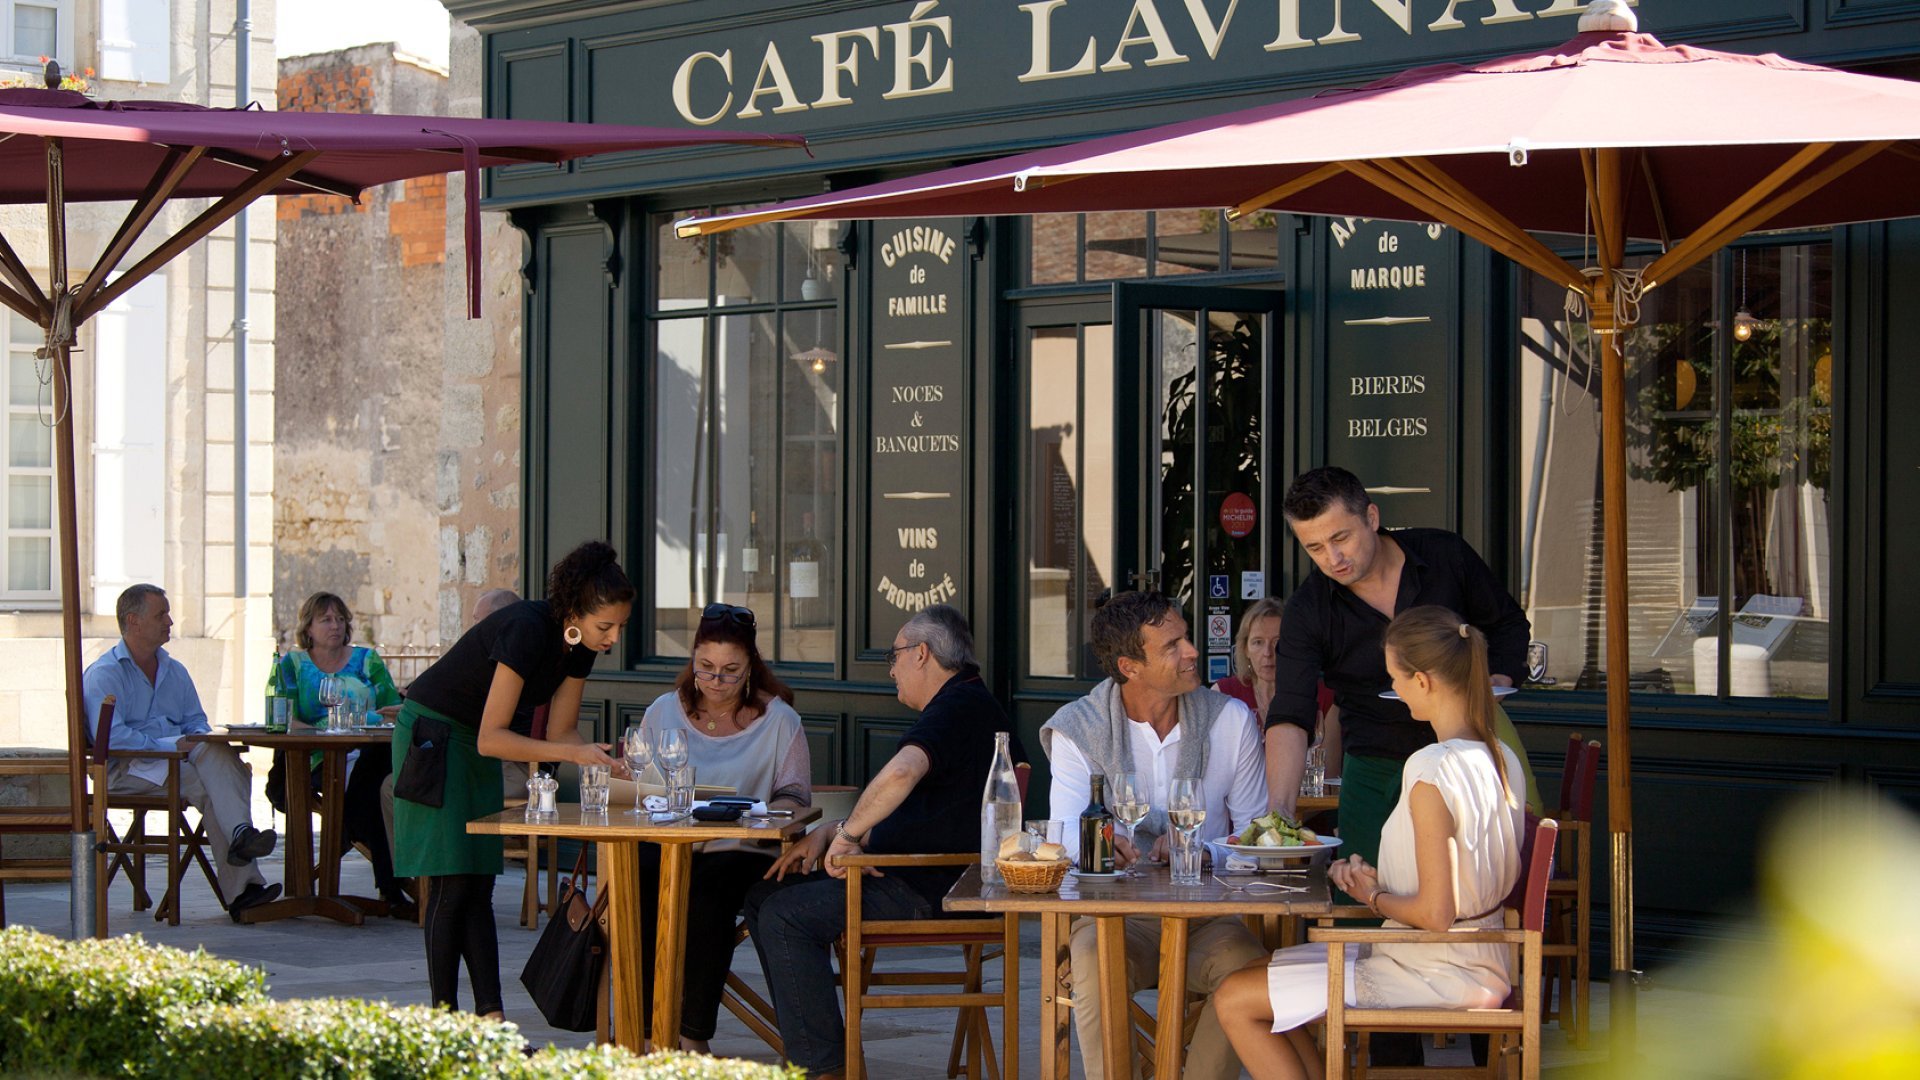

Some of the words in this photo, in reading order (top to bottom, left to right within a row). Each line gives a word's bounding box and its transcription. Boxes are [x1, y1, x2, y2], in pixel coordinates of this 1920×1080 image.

[671, 0, 954, 126] CAFÉ
[1017, 0, 1639, 83] LAVI
[881, 226, 956, 268] CUISINE
[1378, 231, 1398, 253] de
[909, 264, 926, 285] de
[1351, 265, 1426, 290] MARQUE
[888, 294, 947, 318] FAMILLE
[891, 384, 943, 404] NOCES
[1350, 375, 1426, 396] BIERES
[910, 410, 924, 428] &
[1348, 417, 1428, 438] BELGES
[875, 434, 960, 454] BANQUETS
[897, 527, 938, 550] VINS
[908, 558, 925, 578] de
[877, 572, 957, 613] PROPRIÉTÉ
